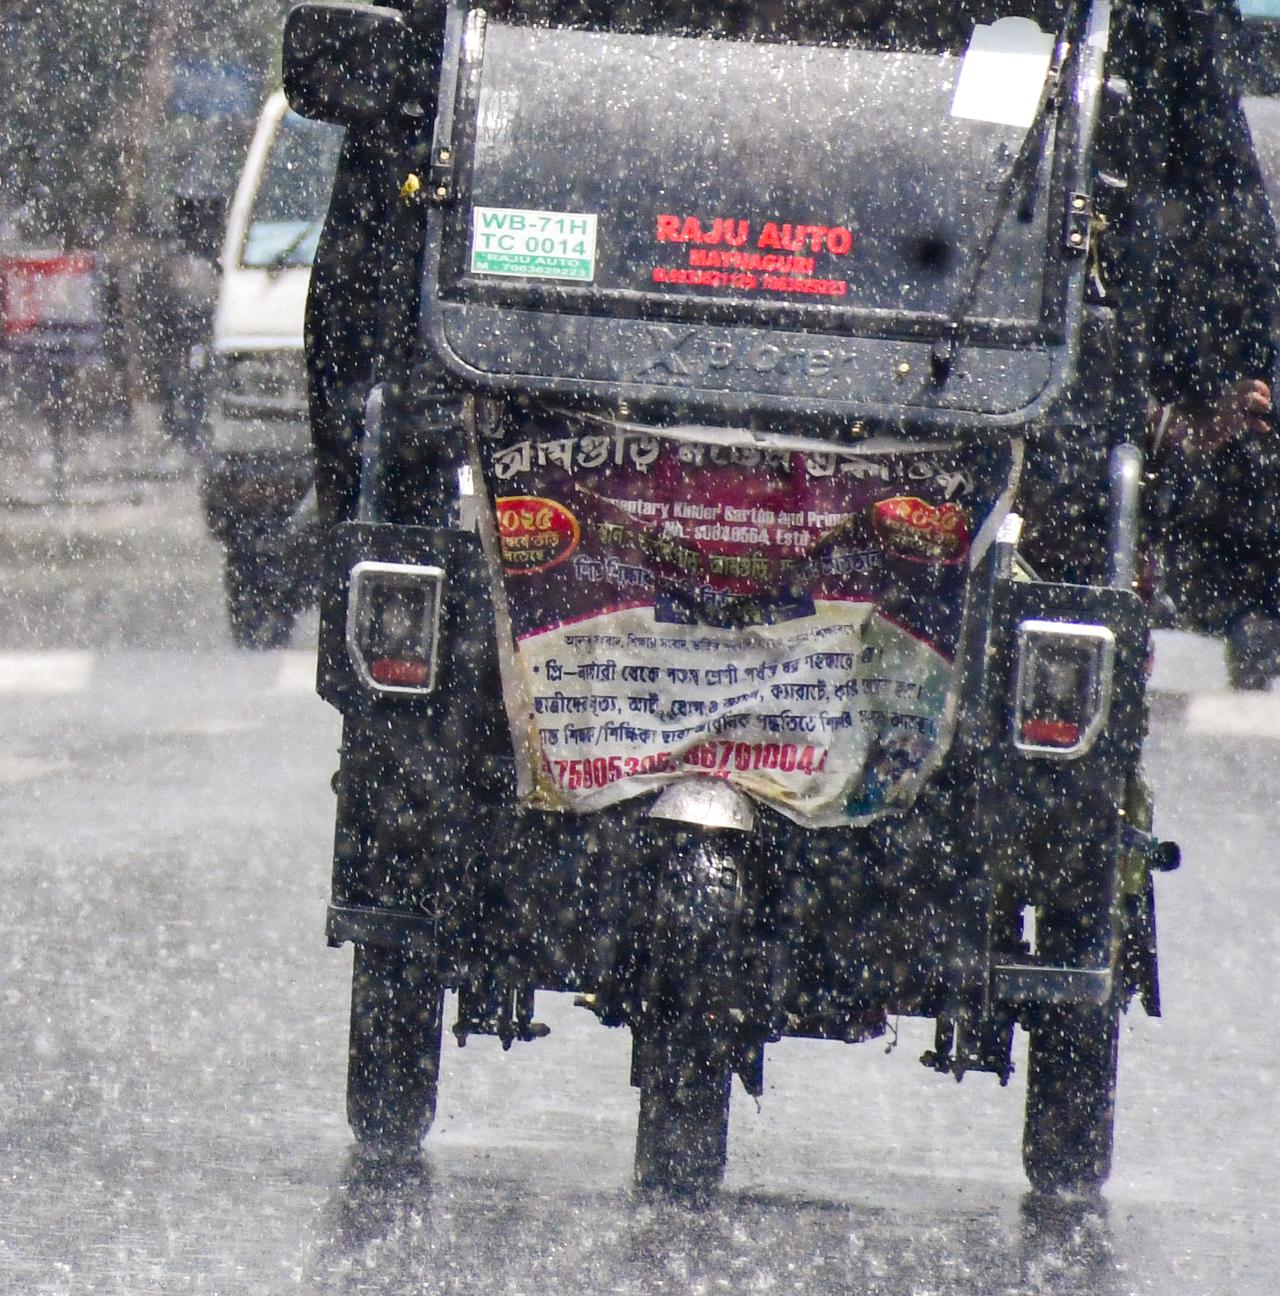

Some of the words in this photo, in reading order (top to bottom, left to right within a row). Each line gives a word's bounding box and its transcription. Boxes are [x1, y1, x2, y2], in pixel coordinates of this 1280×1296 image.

[481, 212, 587, 236] WB-71H
[656, 214, 749, 246] RAJU
[758, 221, 853, 254] AUTO
[480, 233, 515, 251] TC
[525, 236, 587, 257] 0014
[486, 251, 531, 264] RAJU
[535, 255, 580, 268] AUTO
[496, 507, 553, 532] ০২৫
